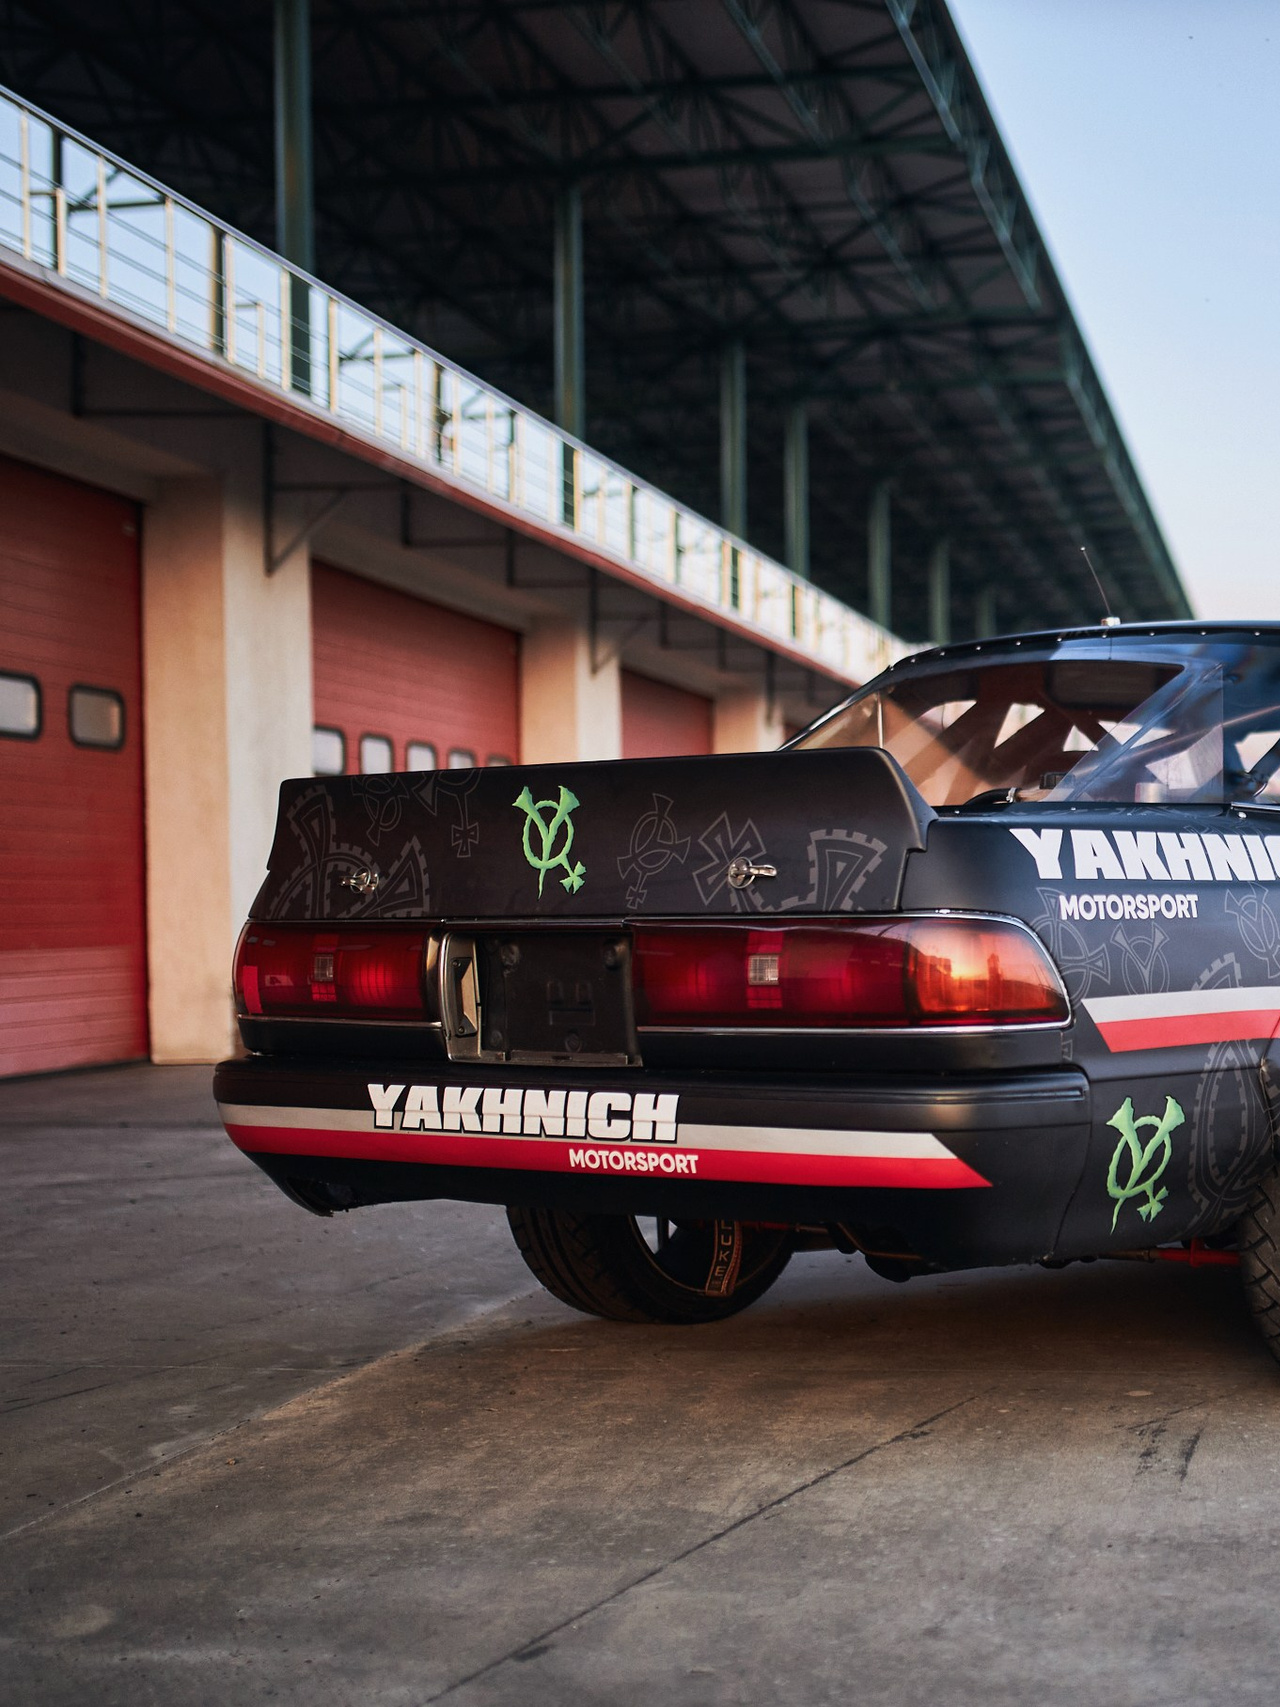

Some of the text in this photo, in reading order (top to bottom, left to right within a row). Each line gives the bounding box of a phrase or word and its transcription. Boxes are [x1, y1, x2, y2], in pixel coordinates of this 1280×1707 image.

[1059, 893, 1199, 921] MOTORSPORT
[367, 1084, 680, 1142] YAKHNICH
[569, 1149, 699, 1174] MOTORSPORT
